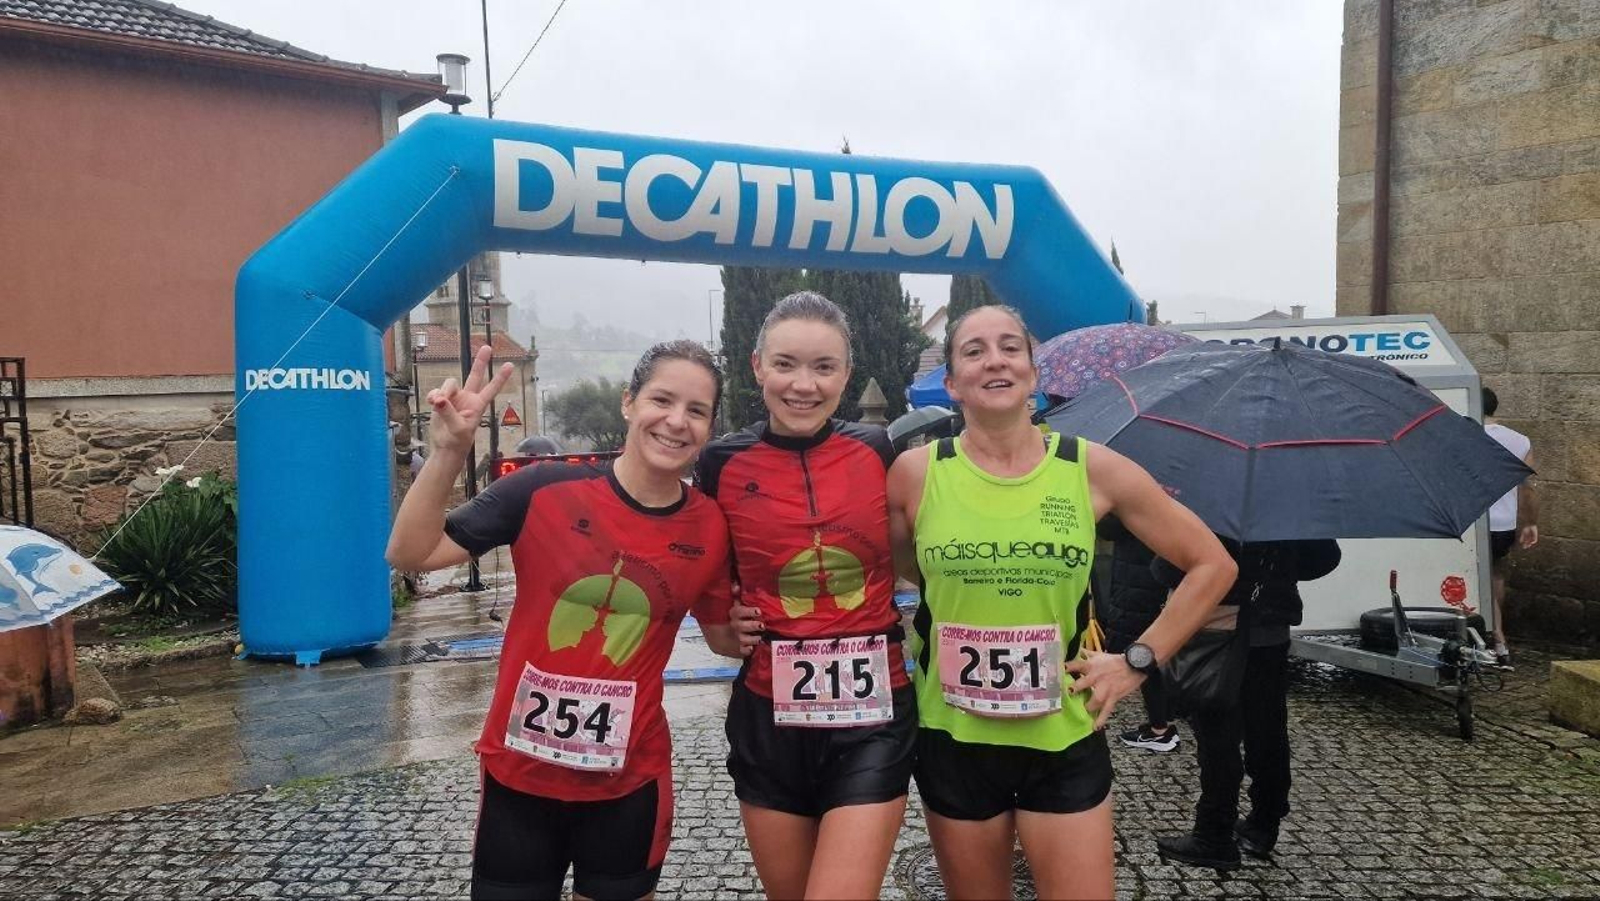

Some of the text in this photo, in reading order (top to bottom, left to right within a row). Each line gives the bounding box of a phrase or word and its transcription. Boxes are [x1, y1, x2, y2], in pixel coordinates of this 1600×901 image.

[493, 138, 1015, 260] DECATHLON
[245, 368, 371, 390] DECATHLON
[1040, 503, 1076, 513] RUNNING
[970, 567, 1022, 577] deportivas
[998, 588, 1023, 597] VIGO
[942, 626, 1056, 643] CORRE-MOS CONTRA O CANCRO
[850, 641, 857, 653] O
[960, 645, 1040, 690] 251
[560, 679, 593, 696] CONTRA
[593, 683, 602, 694] O
[600, 684, 633, 698] CANCRO
[792, 658, 875, 701] 215
[523, 690, 612, 743] 254
